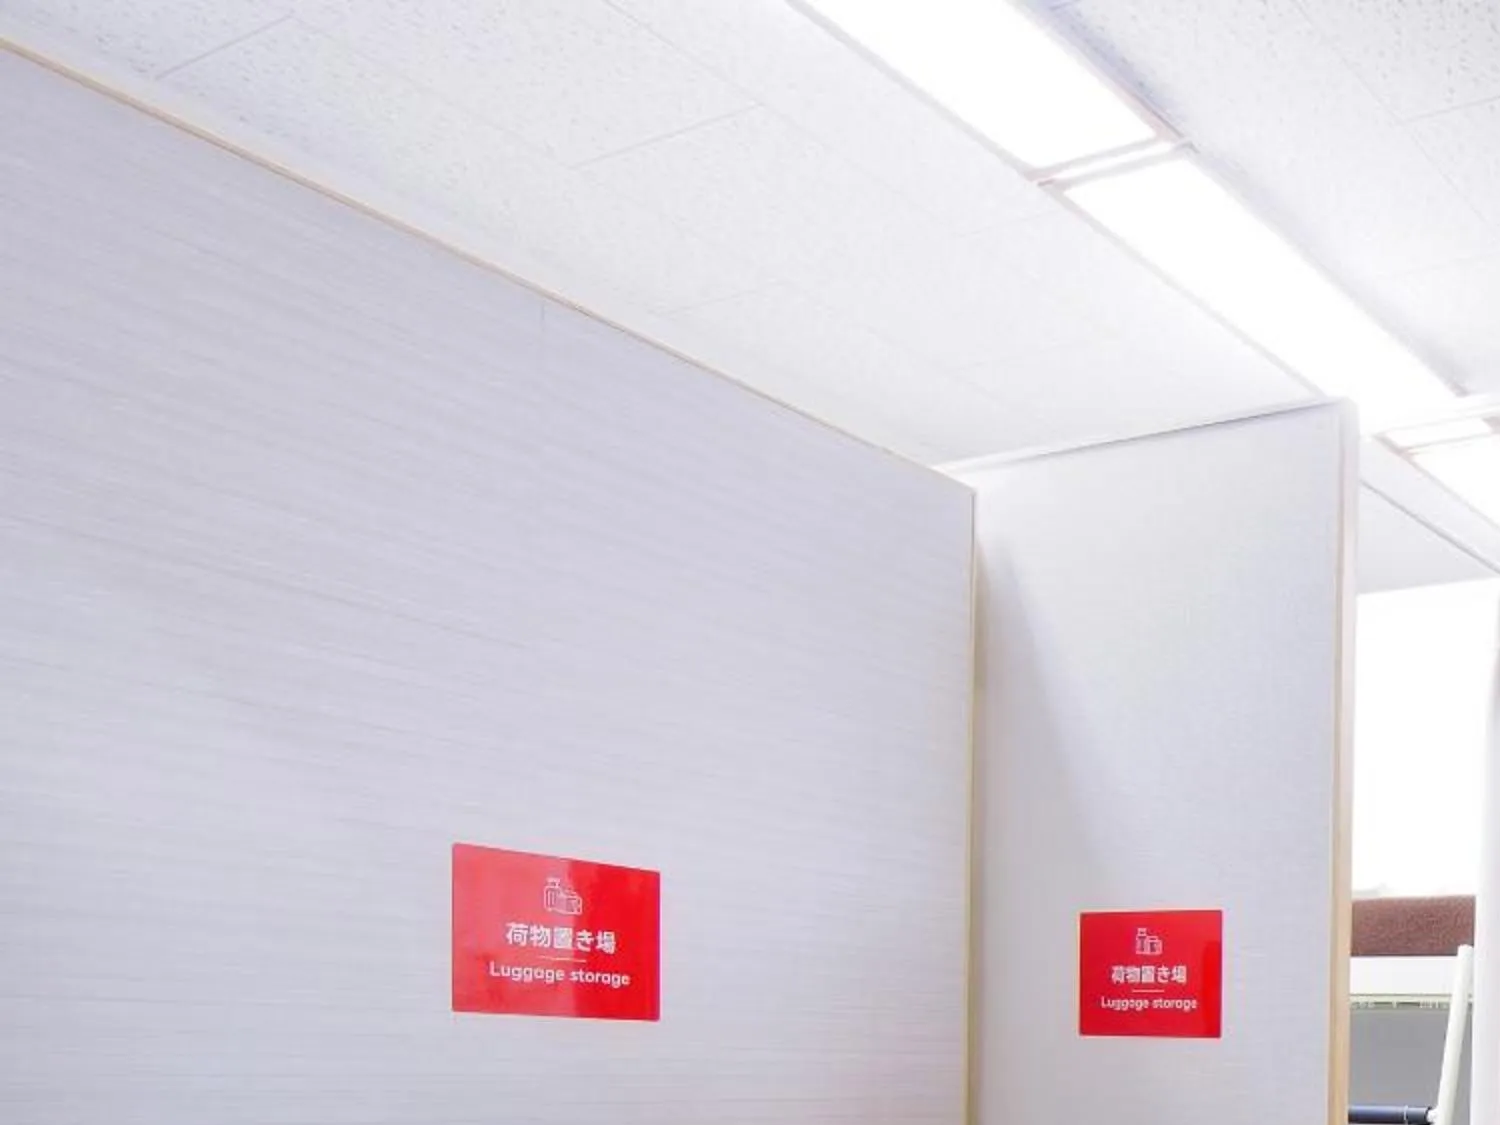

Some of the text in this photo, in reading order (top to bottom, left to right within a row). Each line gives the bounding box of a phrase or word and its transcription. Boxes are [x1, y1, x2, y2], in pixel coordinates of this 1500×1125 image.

[506, 922, 616, 954] 荷物置き場
[489, 961, 630, 988] Luggage storage
[1111, 965, 1187, 984] 荷物置き場
[1101, 996, 1197, 1011] Luggage storage
